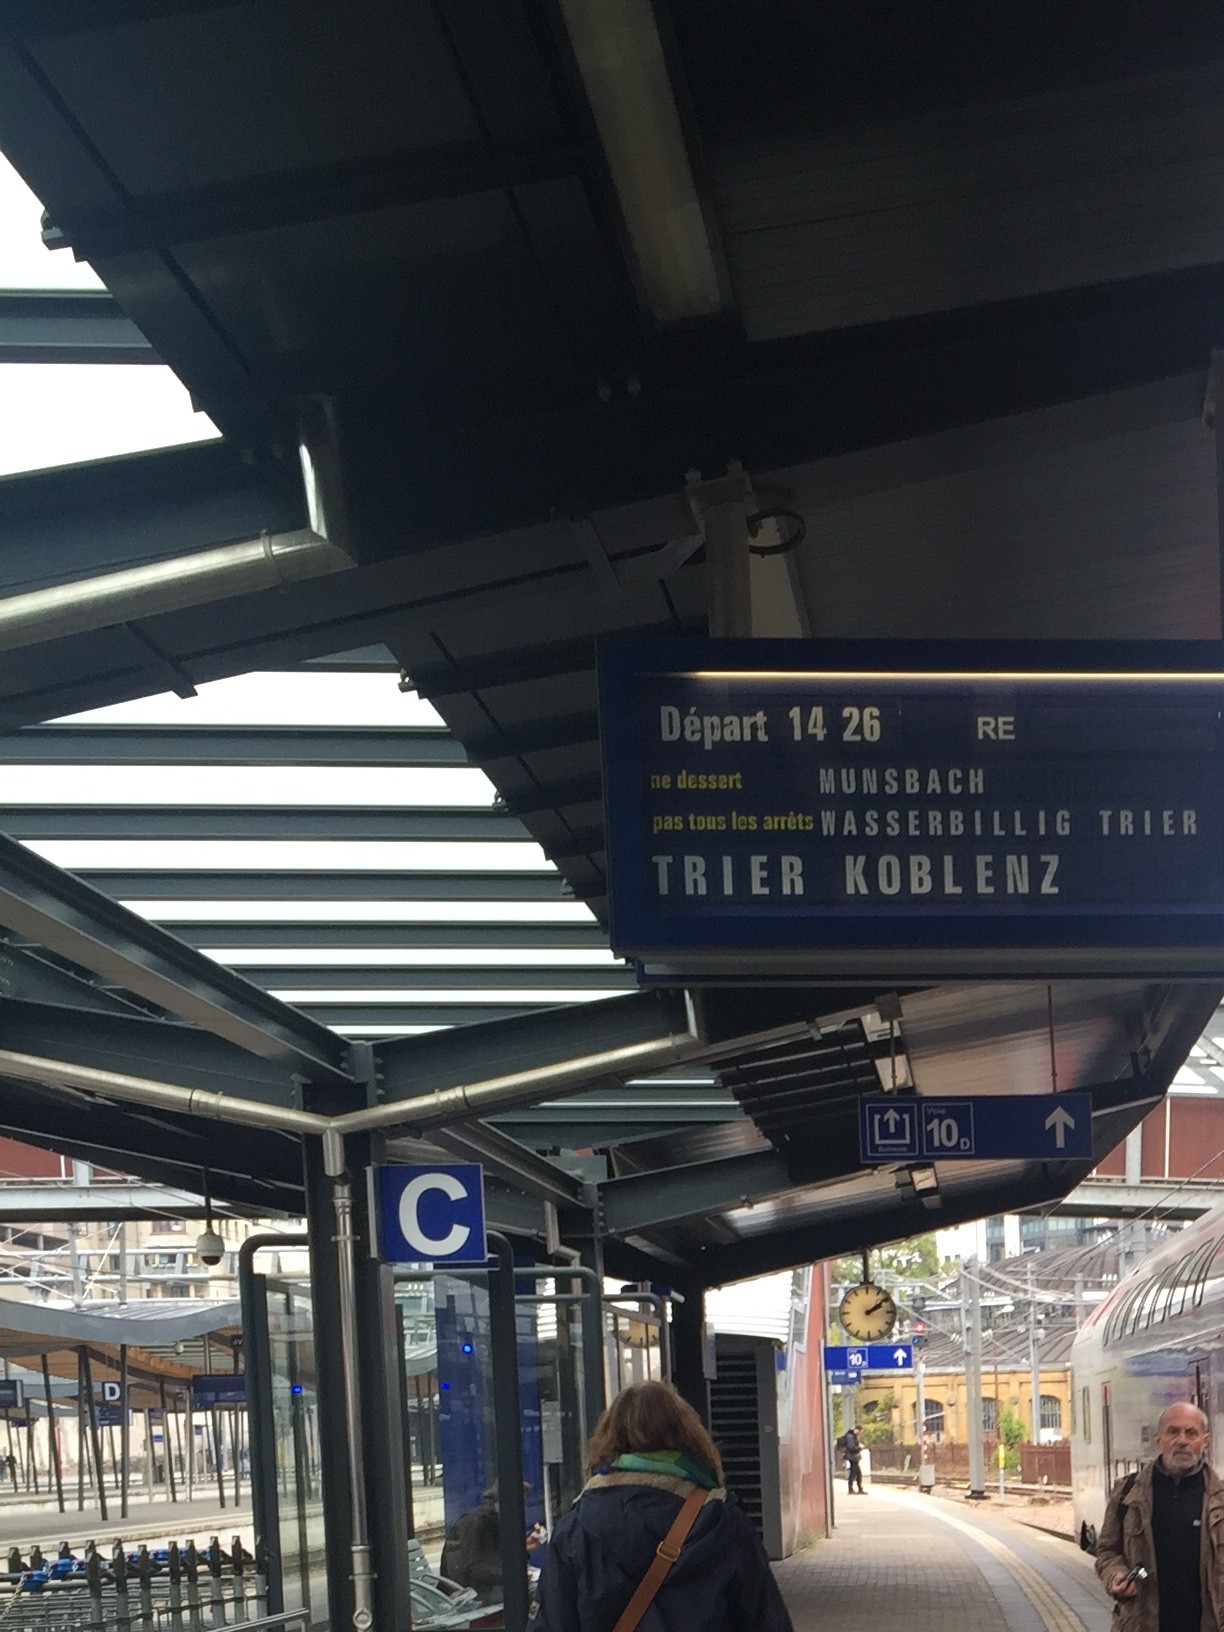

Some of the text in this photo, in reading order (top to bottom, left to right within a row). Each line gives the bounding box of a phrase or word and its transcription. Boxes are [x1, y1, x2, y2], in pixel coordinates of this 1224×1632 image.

[660, 706, 881, 750] Départ 14 26
[977, 716, 1015, 740] RE
[651, 769, 743, 790] ne dessert
[819, 768, 986, 796] MUNSBACH
[653, 811, 814, 834] pas tous les arrêts
[821, 809, 1199, 837] WASSERBILLIG TRIER
[652, 854, 1060, 896] TRIER KOBLENZ
[398, 1172, 471, 1257] C
[104, 1383, 121, 1401] D
